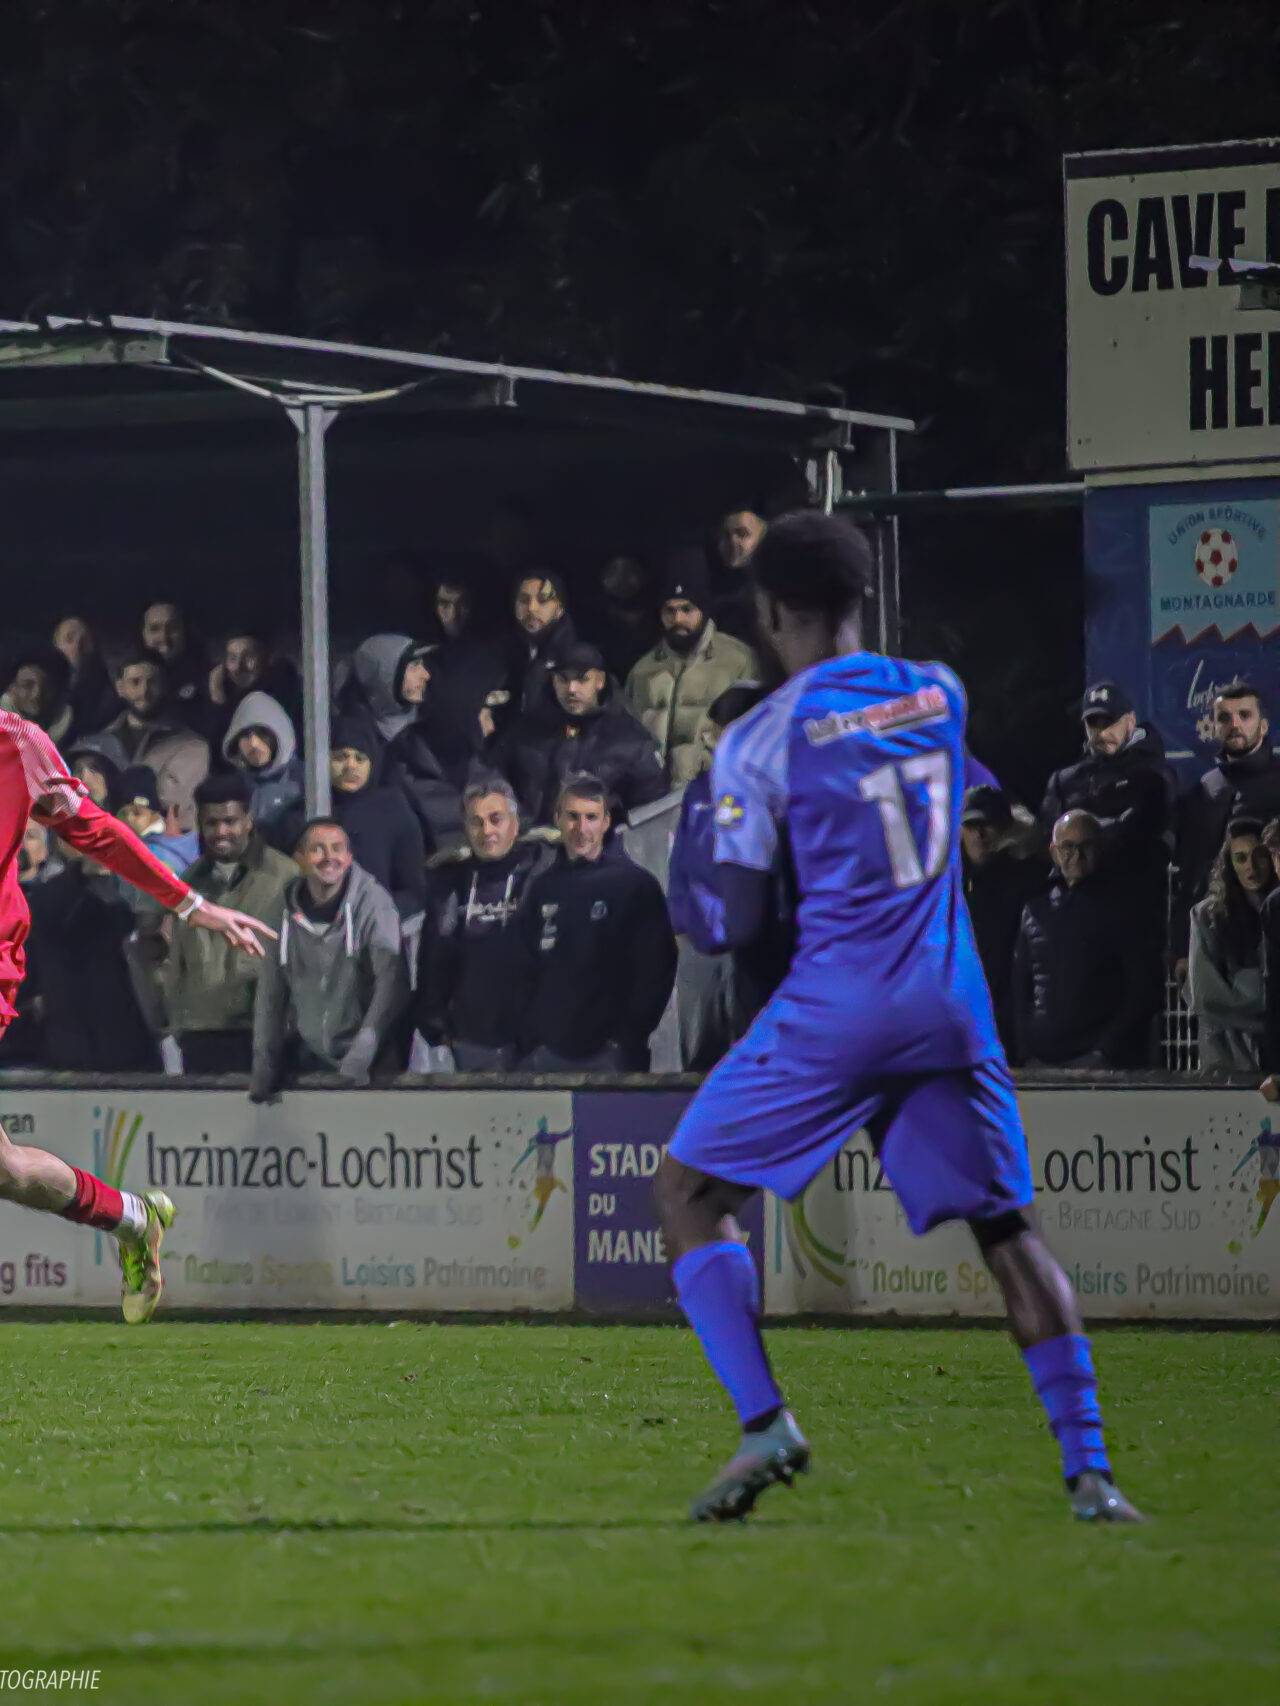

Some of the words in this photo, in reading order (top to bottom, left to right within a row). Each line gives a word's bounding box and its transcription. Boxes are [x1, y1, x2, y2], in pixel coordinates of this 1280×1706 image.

[1087, 190, 1246, 297] CAVE
[1168, 511, 1206, 546] UNION
[1161, 591, 1276, 611] MONTAGNARDE
[859, 752, 950, 888] 17
[147, 1131, 483, 1189] Inzinzac-Lochrist
[588, 1193, 616, 1216] DU
[24, 1252, 67, 1287] fits
[340, 1255, 417, 1288] Loisirs
[423, 1256, 549, 1289] Patrimoine
[872, 1261, 948, 1294] Nature
[1136, 1263, 1270, 1297] Patrimoine
